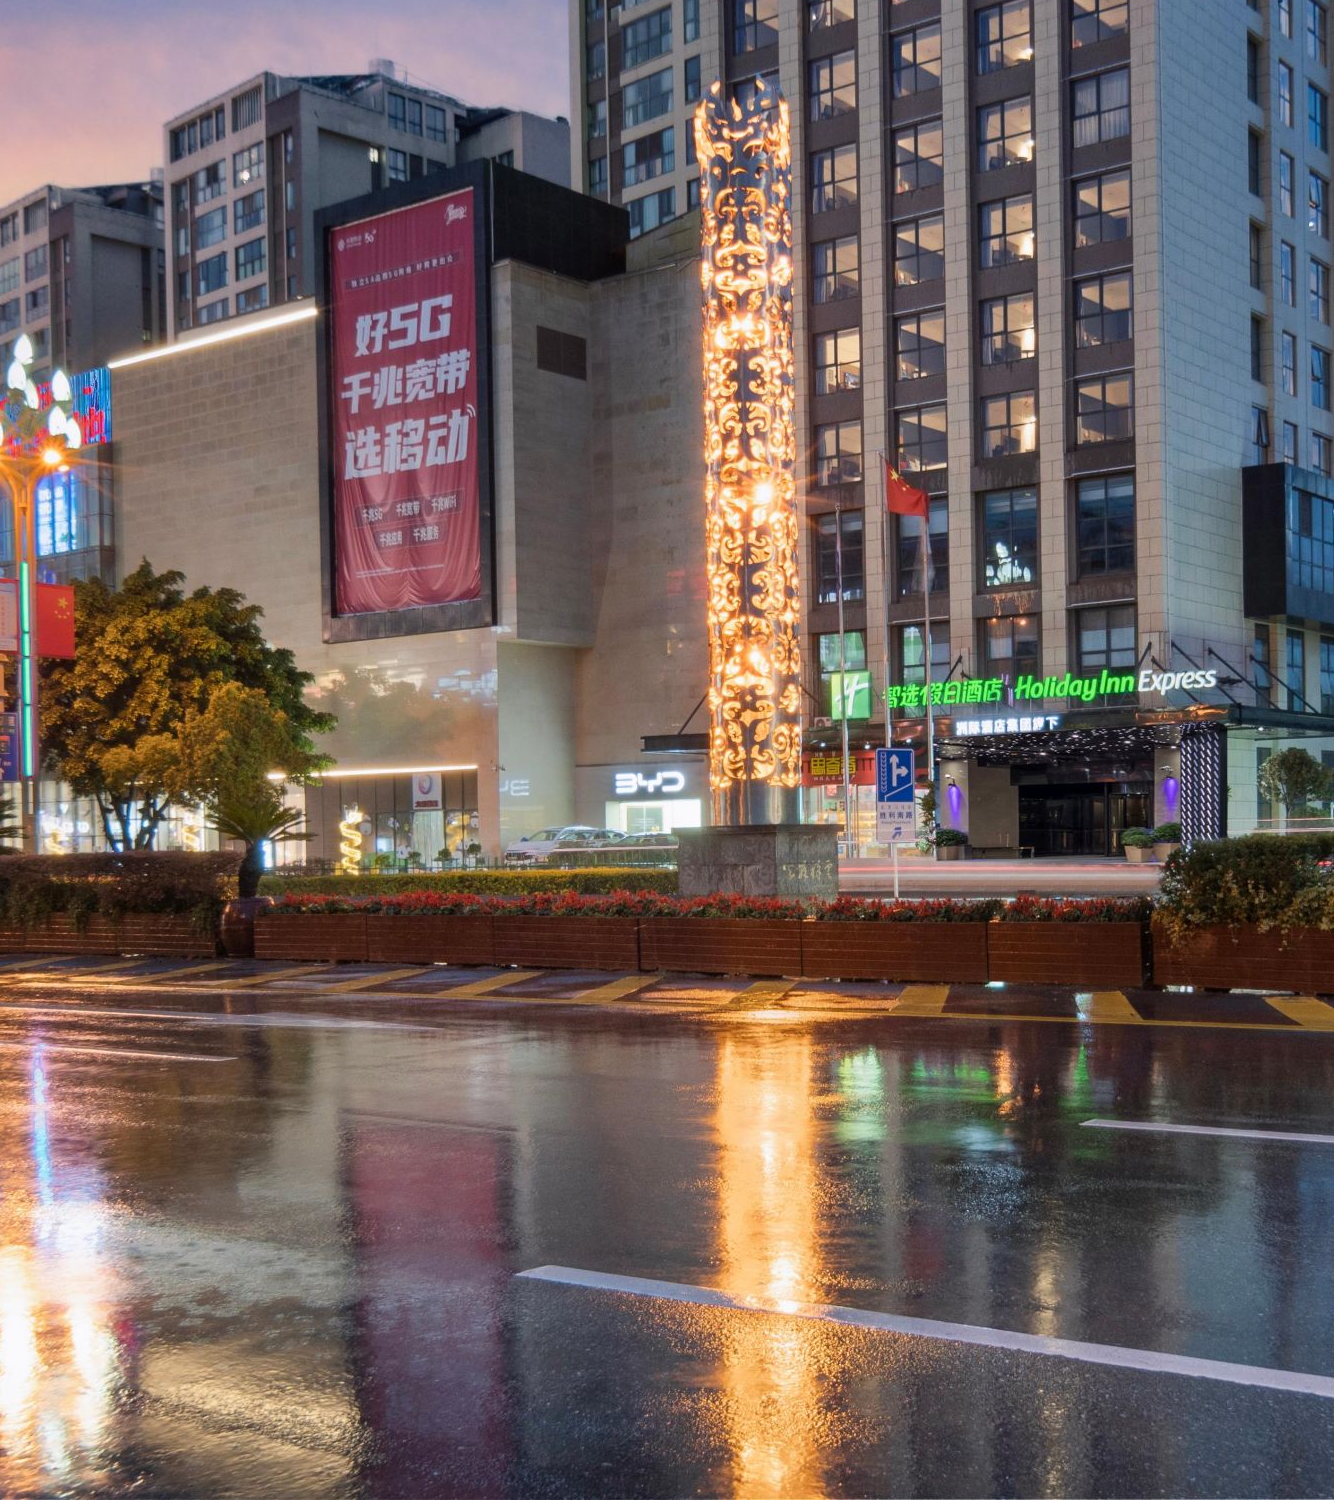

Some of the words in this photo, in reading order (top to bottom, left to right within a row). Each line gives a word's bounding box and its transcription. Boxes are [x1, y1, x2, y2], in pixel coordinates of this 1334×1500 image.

[354, 294, 453, 358] 好5G
[341, 348, 471, 414] 千兆宽带
[343, 408, 470, 480] 选移动
[362, 507, 383, 522] 千兆5G
[395, 501, 420, 517] 千兆宽带
[882, 678, 1003, 709] 智选假日酒店
[1015, 673, 1098, 701] Holiday
[1099, 669, 1135, 695] Inn
[1138, 669, 1217, 696] Express
[615, 771, 686, 795] BYD
[879, 810, 913, 820] 胜利南路
